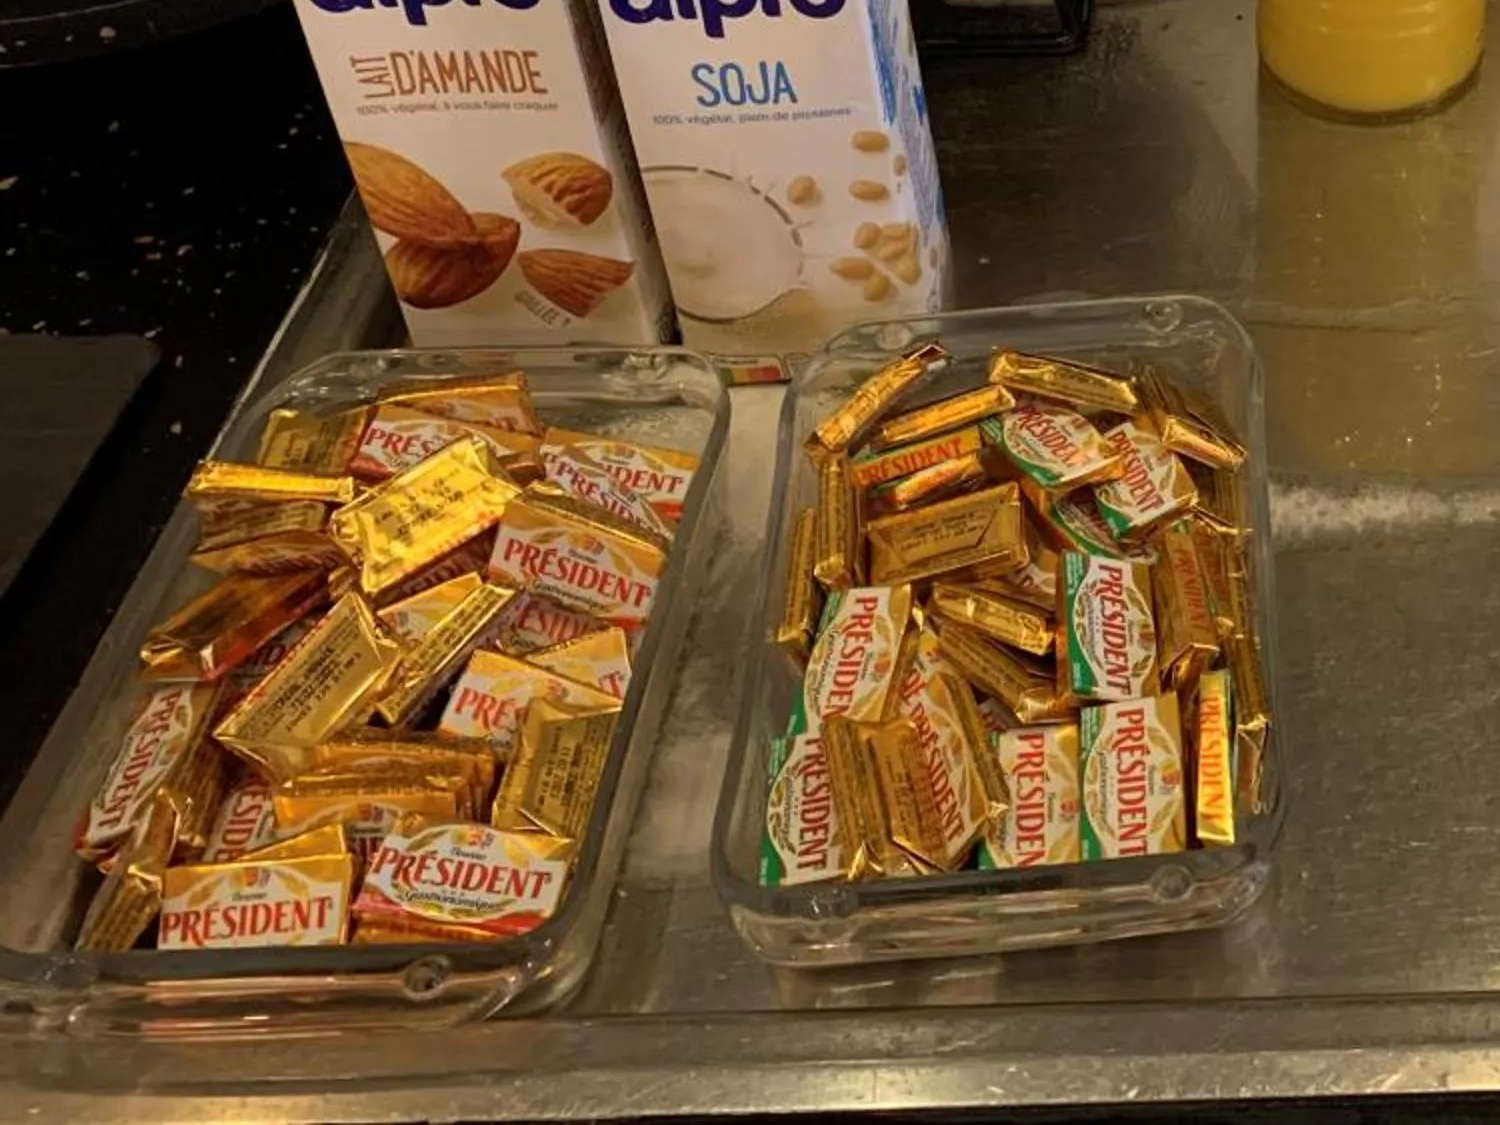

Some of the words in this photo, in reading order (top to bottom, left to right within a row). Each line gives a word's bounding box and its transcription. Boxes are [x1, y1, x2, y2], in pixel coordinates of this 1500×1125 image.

[350, 55, 396, 99] LAIT
[389, 49, 549, 97] D'AMANDE
[690, 60, 798, 107] SOJA
[504, 537, 653, 607] PRÉSIDENT
[821, 596, 879, 721] PRÉSIDEN
[1094, 564, 1132, 696] PRÉSIDENT
[1010, 732, 1047, 869] PRÉSIDEN
[371, 846, 552, 900] PRÉSIDENT
[161, 894, 333, 947] PRÉSIDENT
